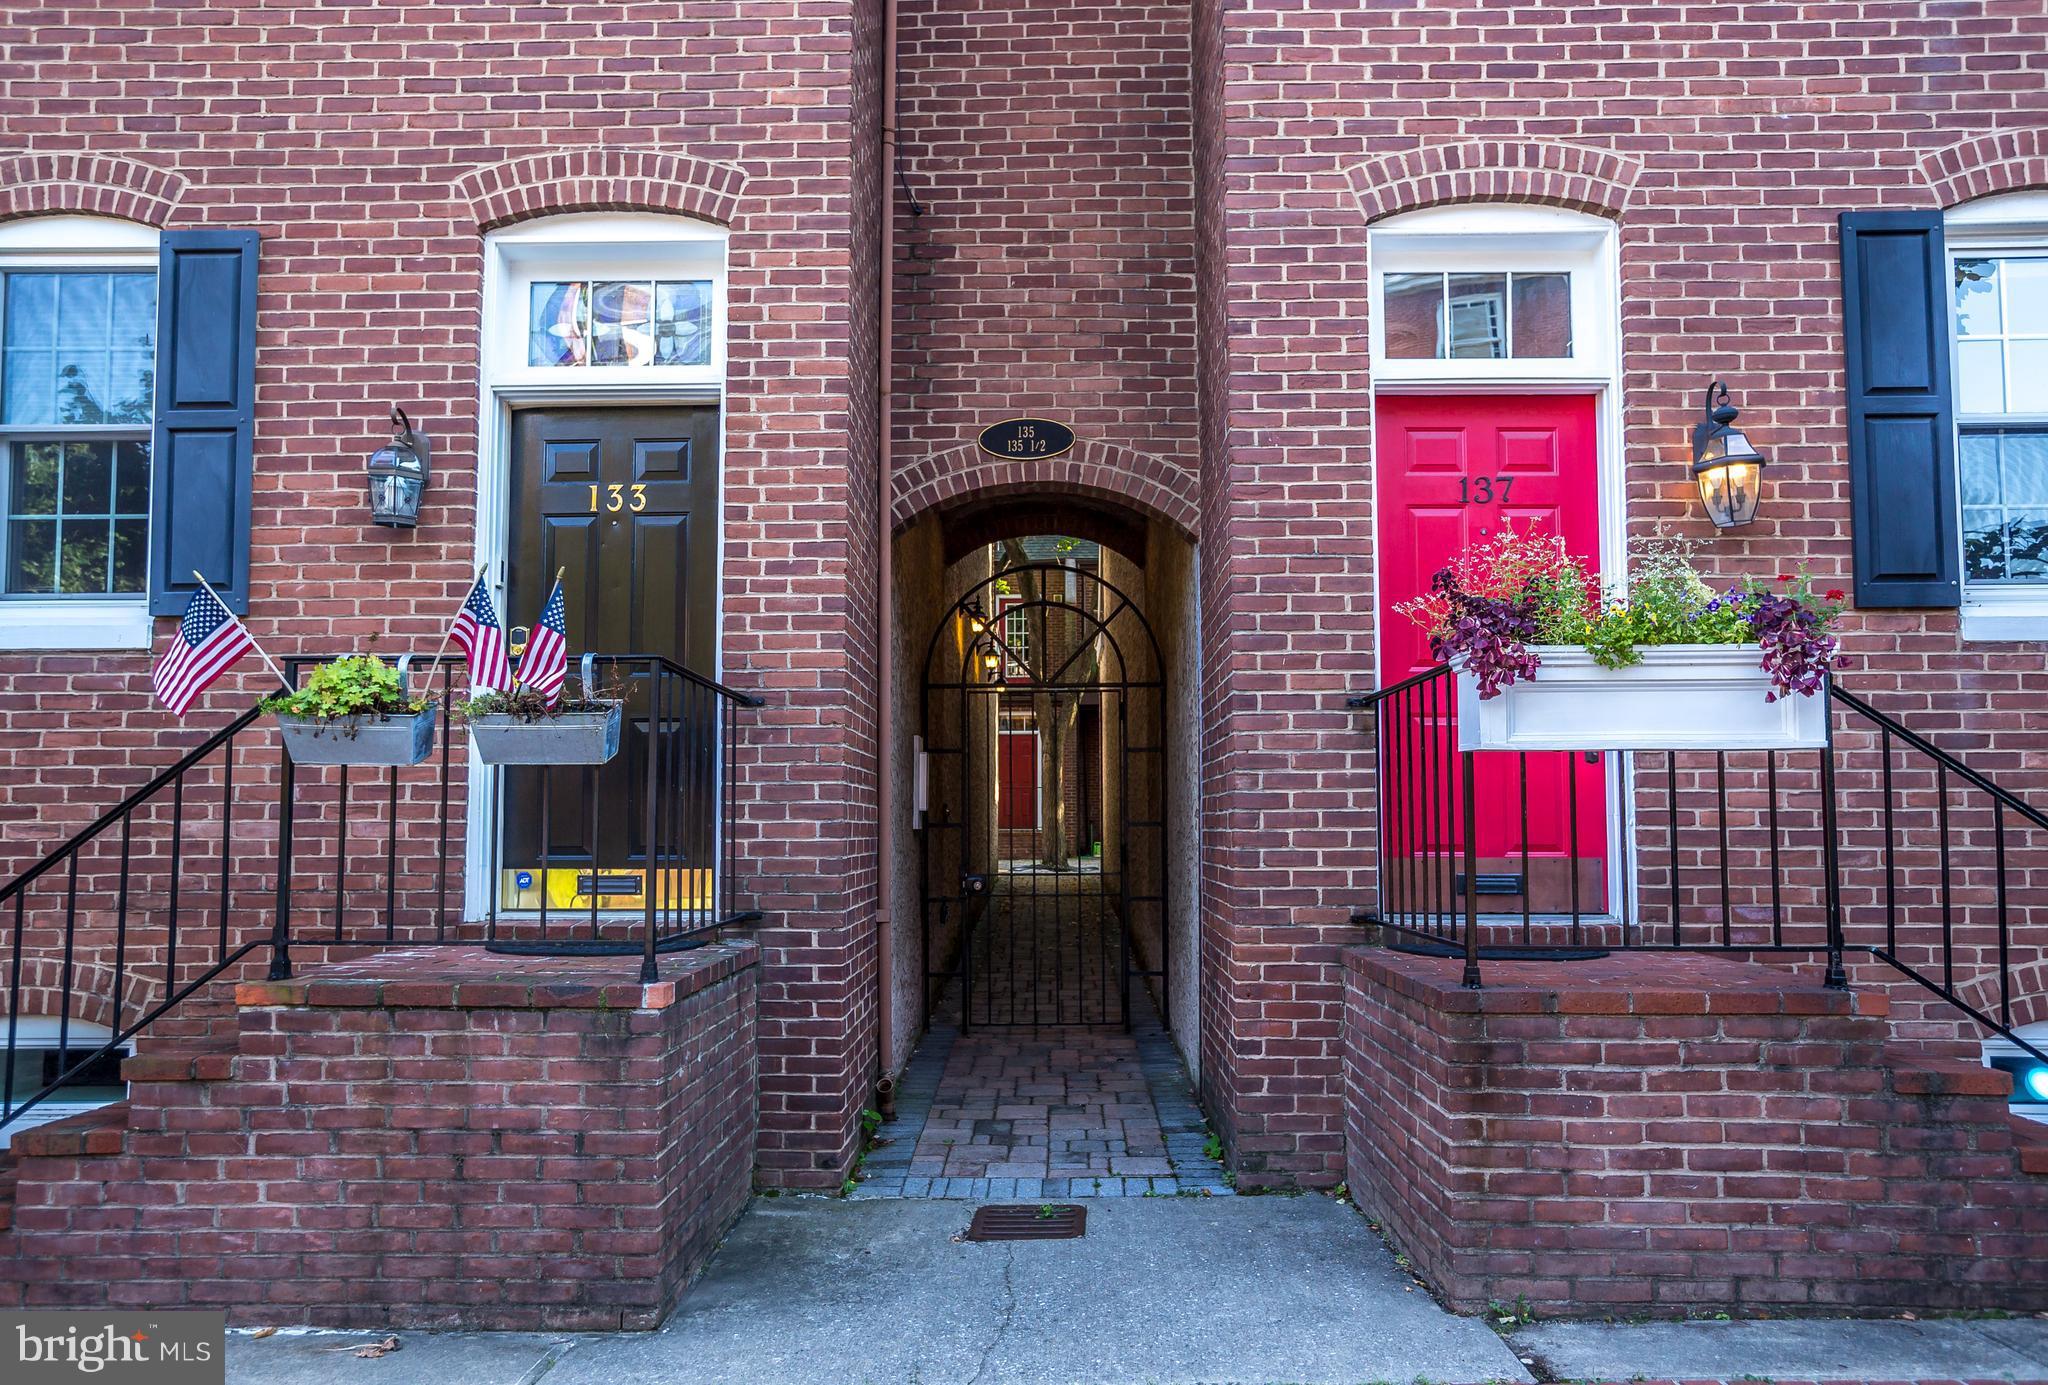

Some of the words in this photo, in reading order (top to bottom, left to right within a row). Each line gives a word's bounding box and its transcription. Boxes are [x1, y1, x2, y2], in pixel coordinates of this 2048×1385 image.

[1018, 426, 1035, 438] 135
[1007, 440, 1023, 452] 135
[1031, 440, 1046, 452] 1/2
[589, 484, 647, 513] 133
[1457, 476, 1514, 504] 137
